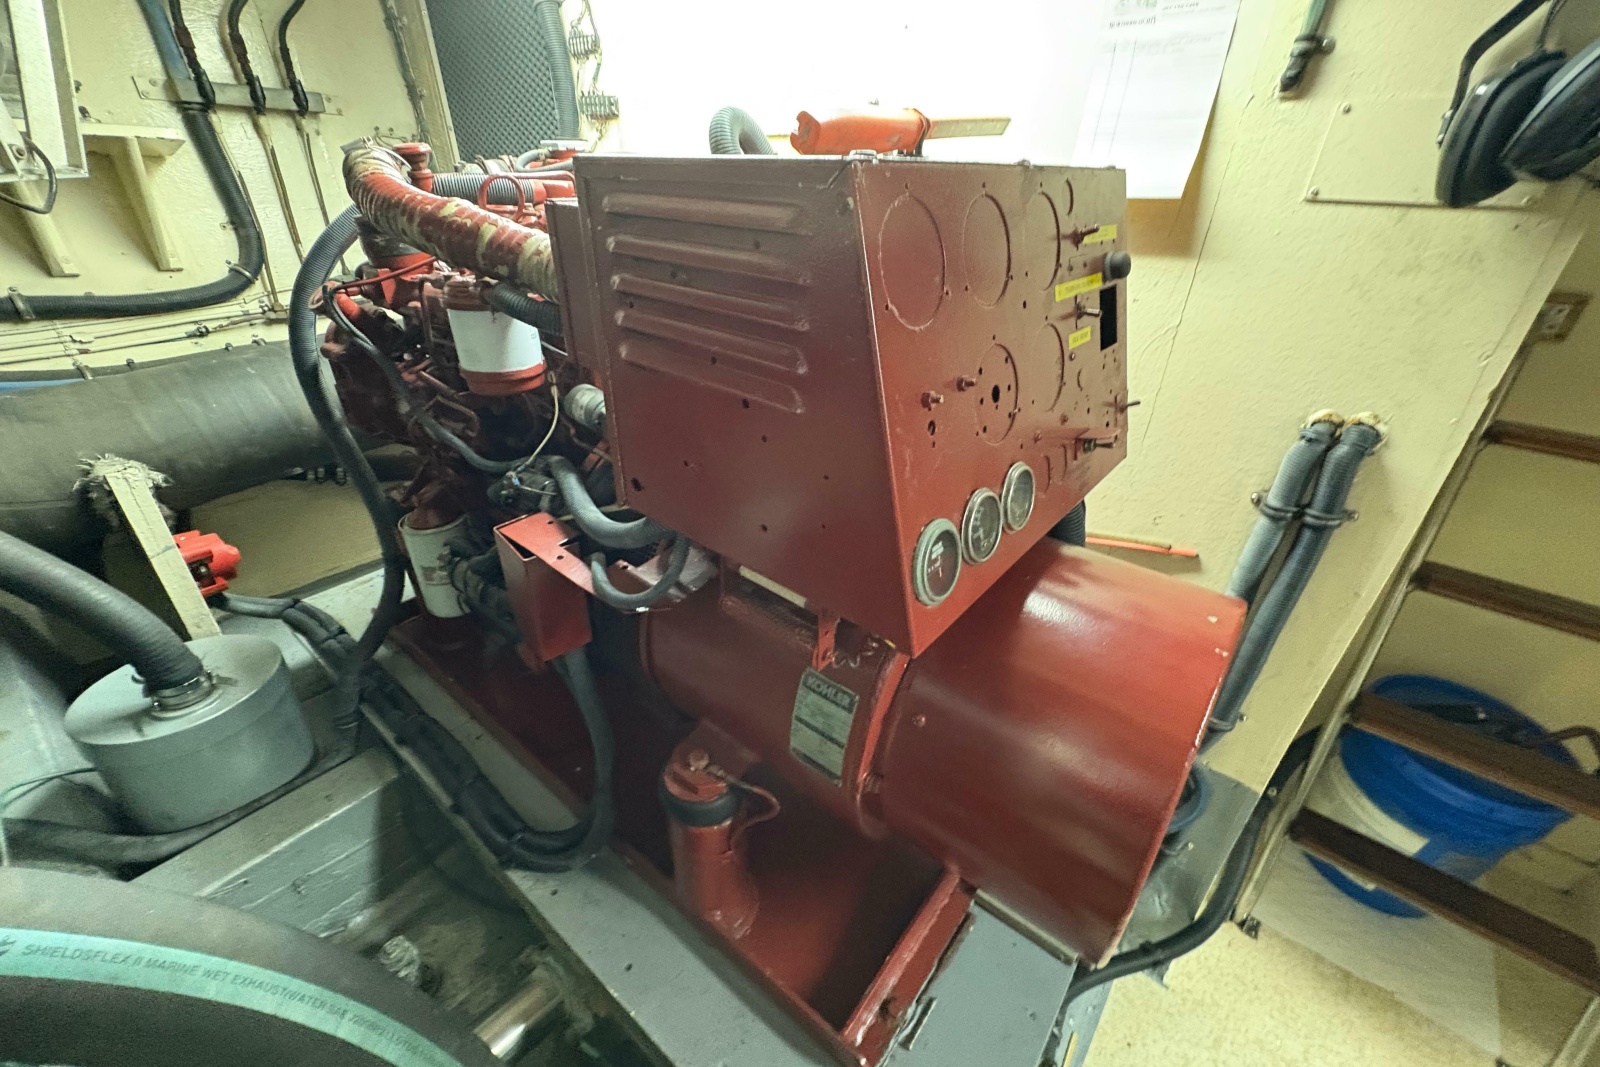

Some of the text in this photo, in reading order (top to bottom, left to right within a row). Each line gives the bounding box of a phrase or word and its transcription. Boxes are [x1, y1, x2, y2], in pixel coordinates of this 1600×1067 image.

[806, 675, 850, 708] KOHLER
[21, 943, 131, 965] SHIELDSFLEX
[143, 957, 202, 977] MARINE
[202, 967, 231, 983] WET
